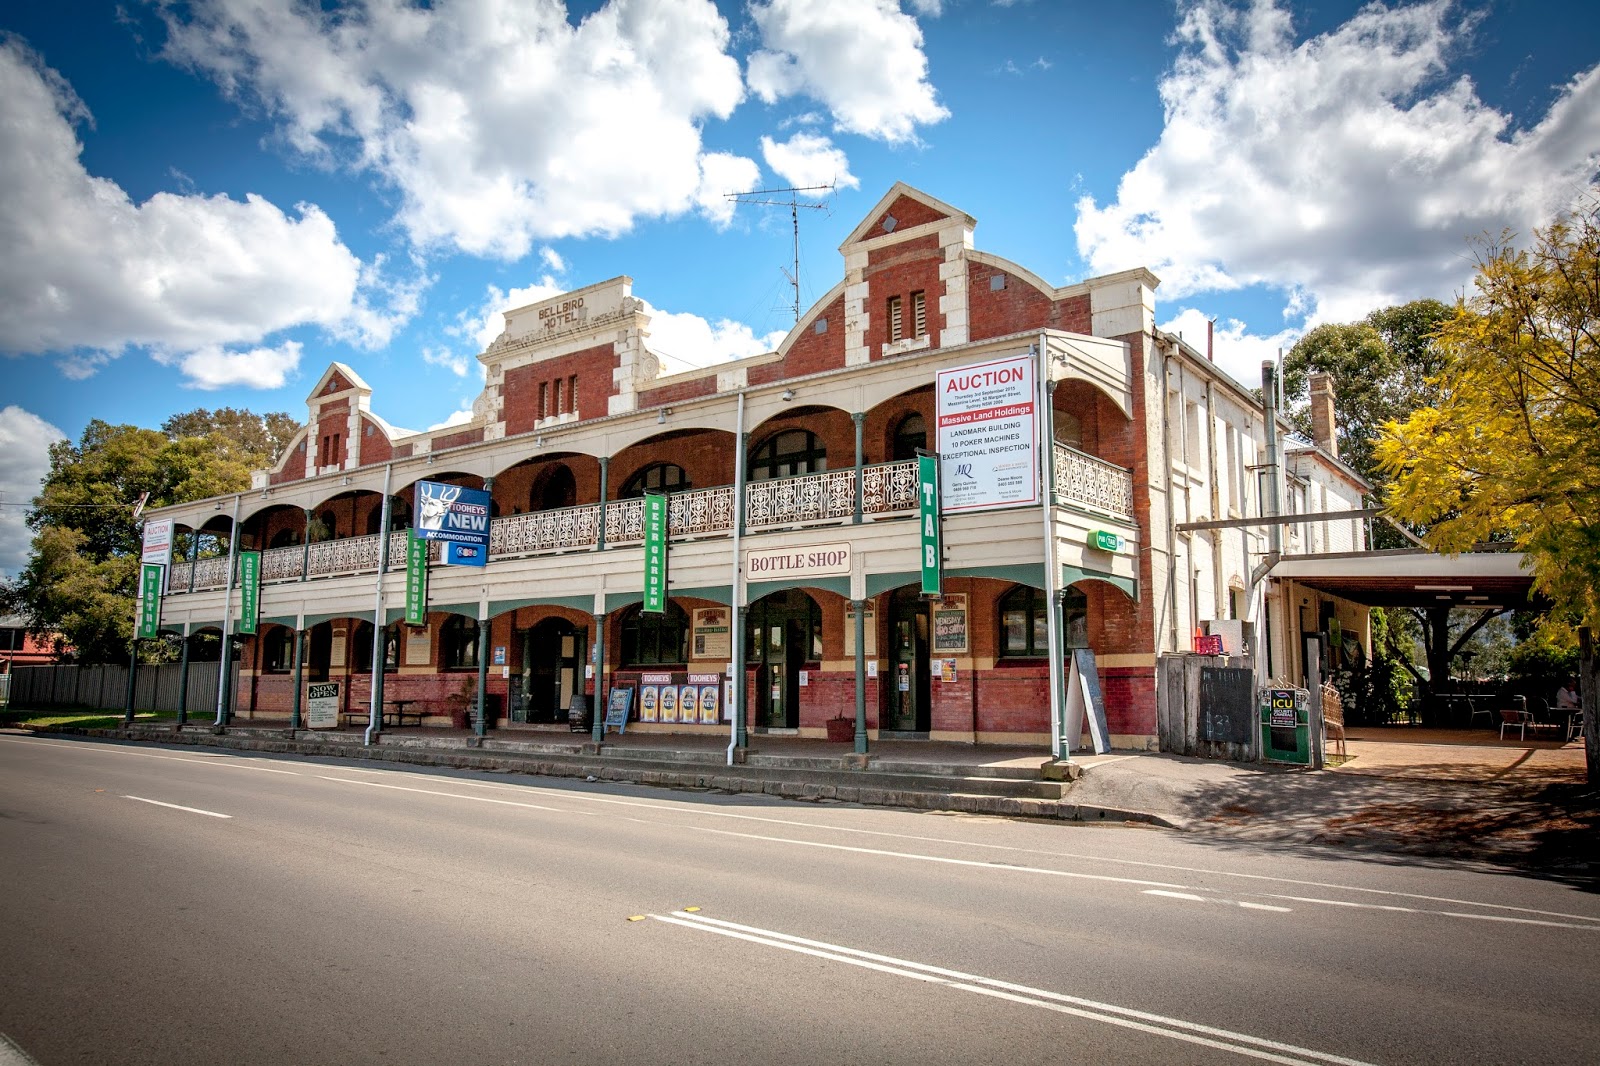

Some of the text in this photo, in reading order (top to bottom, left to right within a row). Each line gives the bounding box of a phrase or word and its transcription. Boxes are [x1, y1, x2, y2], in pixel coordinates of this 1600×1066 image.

[539, 298, 584, 320] BELLBIRD
[544, 312, 578, 330] HOTEL
[946, 366, 1024, 393] AUCTION
[982, 388, 1005, 397] September
[966, 402, 981, 410] Sydney
[942, 406, 1030, 425] Massive Land Holdings
[950, 422, 1021, 438] LANDMARK BUILDING
[960, 438, 982, 447] POKER
[984, 433, 1020, 444] MACHINES
[943, 443, 1030, 460] EXCEPTIONAL INSPECTION
[954, 463, 974, 478] MQ
[452, 503, 486, 514] TOOHEYS
[148, 525, 168, 535] AUCTION
[448, 513, 487, 531] NEW
[923, 482, 935, 568] TAB
[426, 531, 482, 542] ACCOMMODATION
[751, 550, 847, 572] BOTTLE SHOP
[411, 539, 420, 619] LAYGROUND
[650, 546, 658, 606] GARDEN
[145, 571, 156, 633] BISTRO
[690, 674, 718, 682] TOOHEYS
[310, 690, 336, 698] OPEN
[1273, 699, 1293, 708] ICU
